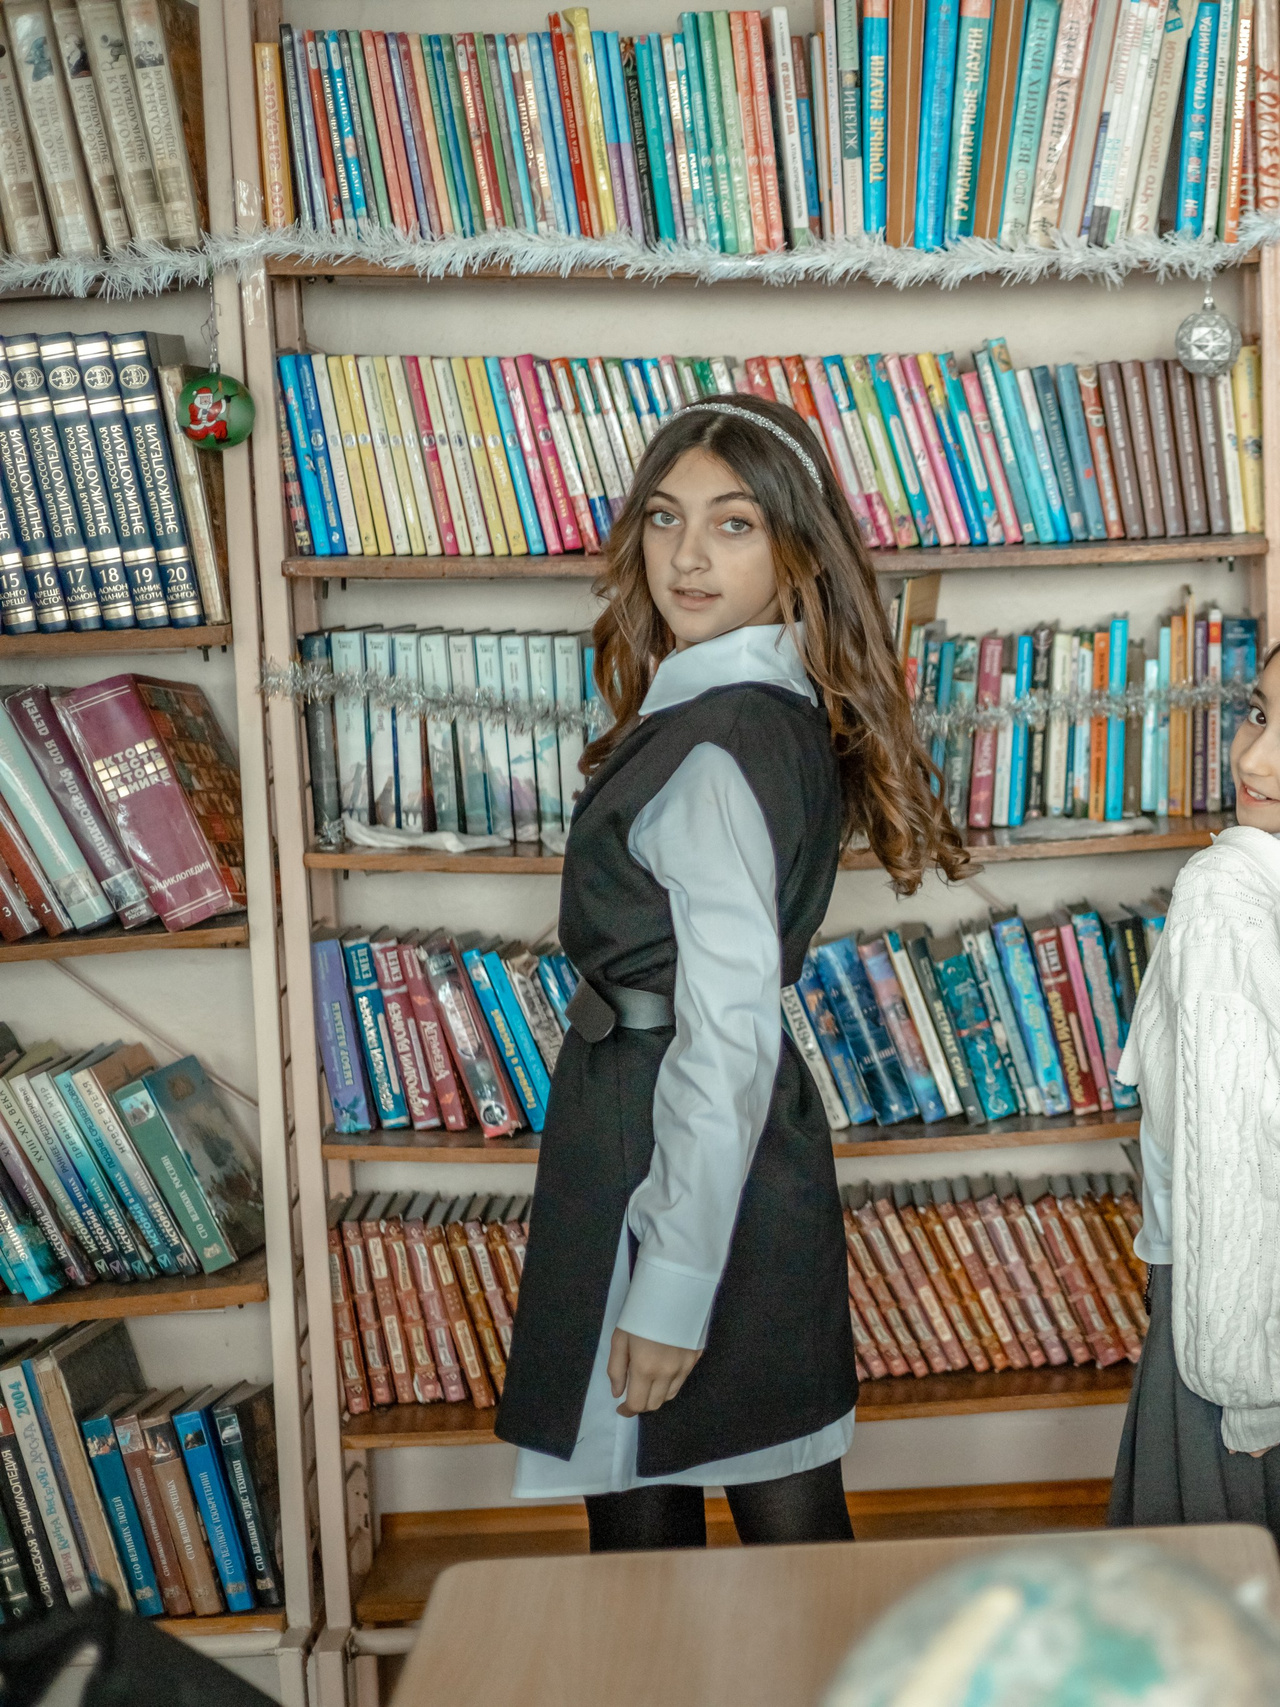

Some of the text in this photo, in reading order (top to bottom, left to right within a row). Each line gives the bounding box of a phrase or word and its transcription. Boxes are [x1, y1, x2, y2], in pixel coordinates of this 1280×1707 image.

[559, 51, 570, 96] КОМАНДИРА
[1194, 16, 1212, 109] СТРАНЫ МИРА
[1234, 19, 1251, 119] КНИГА ЗНАНИЙ
[85, 84, 110, 163] ЭНЦИКЛОПЕДИЯ
[120, 74, 146, 160] ЭНЦИКЛОПЕДИЯ
[153, 70, 178, 159] ЭНЦИКЛОПЕДИЯ
[843, 90, 857, 149] ЖИЗНИ
[1016, 78, 1041, 164] ВЕЛИКИХ
[1143, 169, 1157, 203] Что
[1161, 40, 1176, 86] такой
[870, 117, 884, 183] ТОЧНЫЕ
[955, 90, 978, 220] ГУМАНИТАРНЫЕ
[1, 431, 30, 541] БОЛЬШАЯ РОССИЙСКАЯ
[10, 429, 44, 539] ЭНЦИКЛОПЕДИЯ
[30, 428, 62, 538] БОЛЬШАЯ РОССИЙСКАЯ
[41, 425, 77, 535] ЭНЦИКЛОПЕДИЯ
[64, 427, 97, 537] БОЛЬШАЯ РОССИЙСКАЯ
[76, 424, 111, 534] ЭНЦИКЛОПЕДИЯ
[98, 426, 130, 537] БОЛЬШАЯ РОССИЙСКАЯ
[111, 424, 145, 533] ЭНЦИКЛОПЕДИЯ
[133, 426, 164, 536] БОЛЬШАЯ РОССИЙСКАЯ
[145, 424, 178, 533] ЭНЦИКЛОПЕДИЯ
[0, 573, 19, 589] 15
[34, 572, 54, 588] 16
[67, 568, 85, 584] 17
[100, 568, 119, 583] 18
[134, 567, 152, 582] 19
[167, 567, 186, 583] 20
[21, 697, 116, 868] ЭНЦИКЛОПЕДИЯ ДЛЯ ДЕТЕЙ
[103, 748, 136, 767] КТО
[113, 769, 145, 787] КТО
[119, 750, 162, 773] ЕСТЬ
[150, 861, 211, 893] ЭНЦИКЛОПЕДИЯ
[3, 906, 11, 917] 3
[41, 902, 51, 914] 1
[358, 948, 372, 979] ЕМЕЦ
[0, 1090, 16, 1115] ВЕКА
[19, 1086, 57, 1145] СРЕДНЕВЕКОВЬЕ
[40, 1087, 57, 1108] МИР
[65, 1082, 102, 1137] СРЕДНЕВЕКОВЬЕ
[82, 1081, 107, 1115] ВРЕМЯ
[50, 1145, 70, 1173] РАННЕЕ
[53, 1111, 83, 1159] ДРЕВНИЙ
[95, 1137, 115, 1168] ПОЗДНЕЕ
[103, 1117, 127, 1153] НОВОЕ
[151, 1202, 180, 1245] ИСТОРИЯ
[160, 1155, 209, 1239] СТО ВЕЛИКИХ РОССИЯН
[39, 1215, 68, 1258] ИСТОРИЯ
[70, 1210, 98, 1252] ИСТОРИЯ
[86, 1209, 113, 1253] ИСТОРИЯ
[107, 1209, 134, 1252] ИСТОРИЯ
[131, 1203, 159, 1247] ИСТОРИЯ
[8, 1381, 30, 1418] 2004
[3, 1449, 35, 1536] ЭНЦИКЛОПЕДИЯ
[166, 1480, 195, 1560] СТО ВЕЛИКИХ УЧЕНЫХ
[232, 1460, 265, 1571] СТО ВЕЛИКИХ ЧУДЕС ТЕХНИКИ
[112, 1496, 144, 1580] СТО ВЕЛИКИХ ЛЮДЕЙ
[199, 1472, 235, 1575] СТО ВЕЛИКИХ ИЗОБРЕТЕНИЙ
